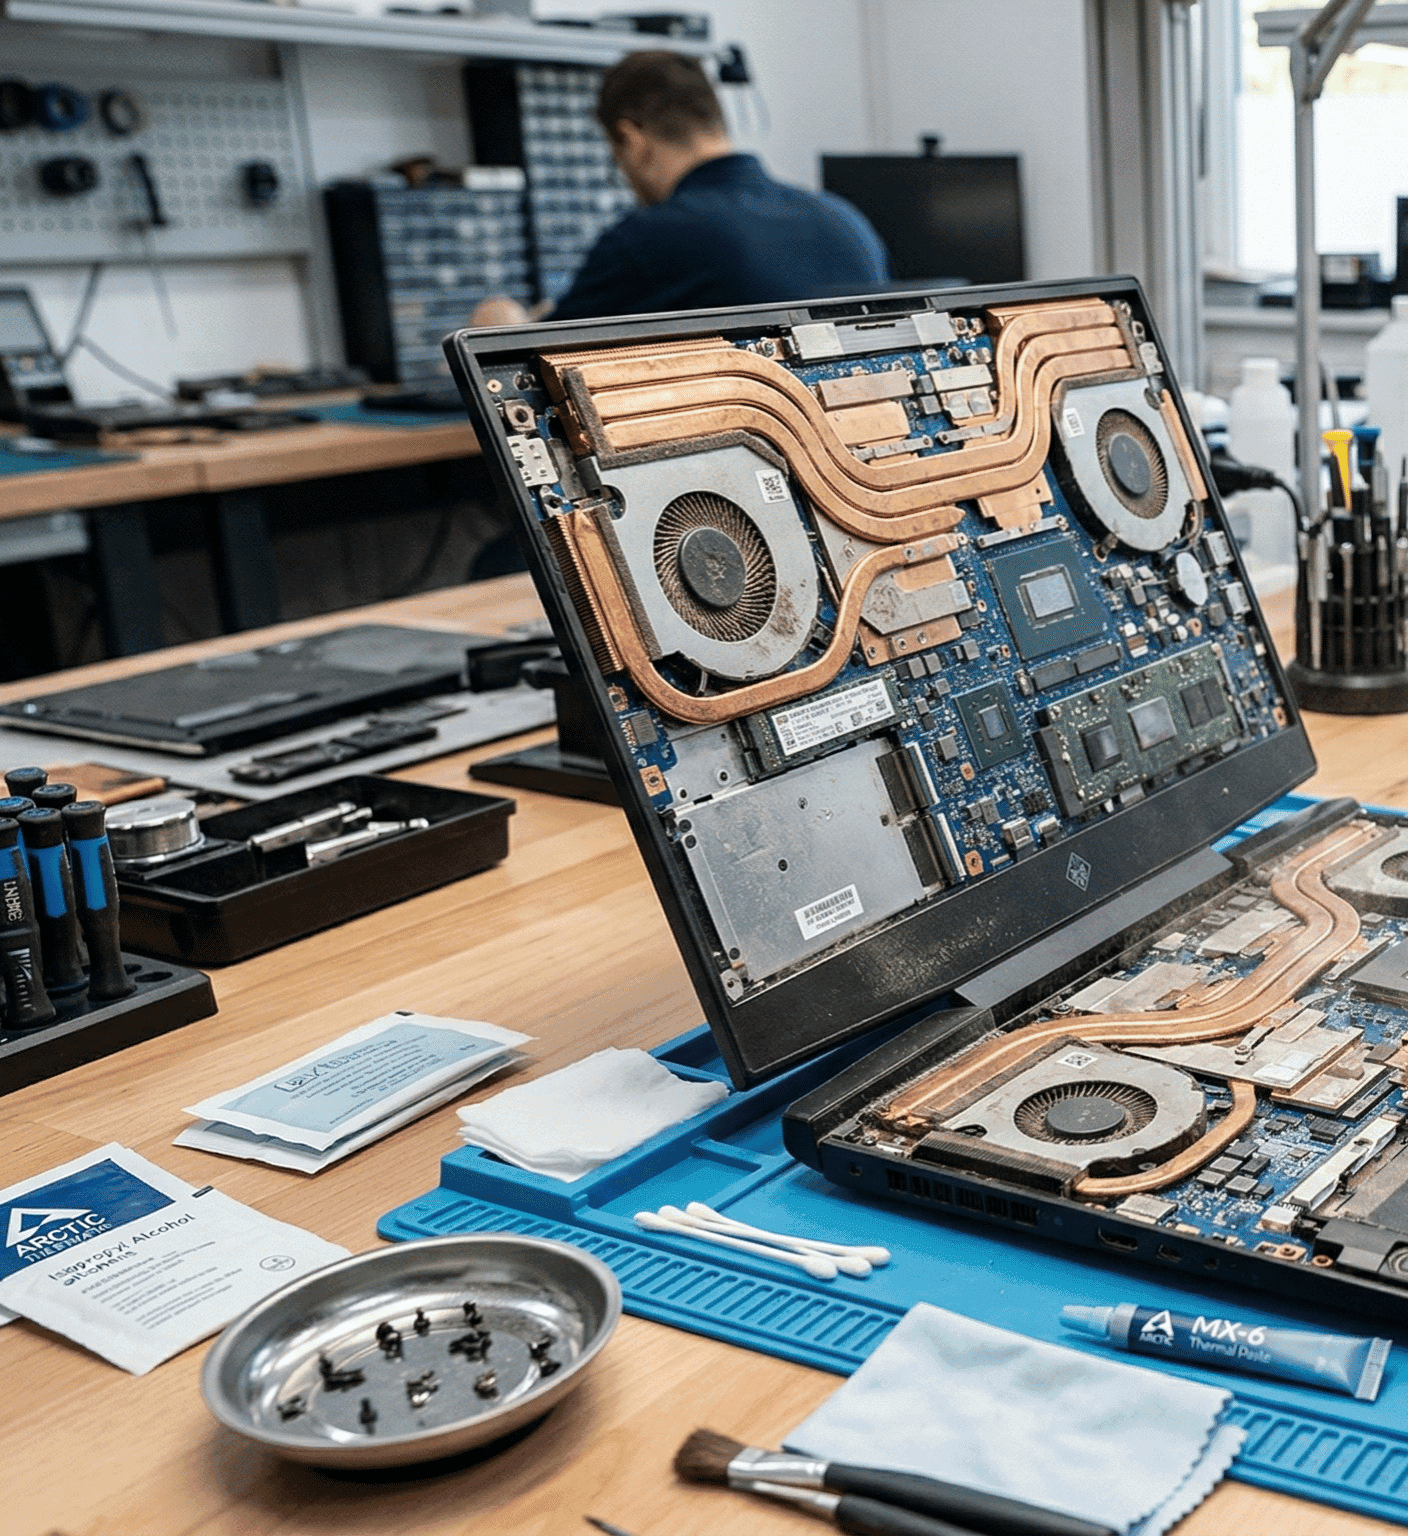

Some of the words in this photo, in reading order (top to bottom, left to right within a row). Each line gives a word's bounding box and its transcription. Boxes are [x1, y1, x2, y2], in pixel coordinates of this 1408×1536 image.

[16, 1213, 106, 1258] ARCTIC
[132, 1213, 196, 1245] Alcohol
[1191, 1316, 1267, 1346] MX-6
